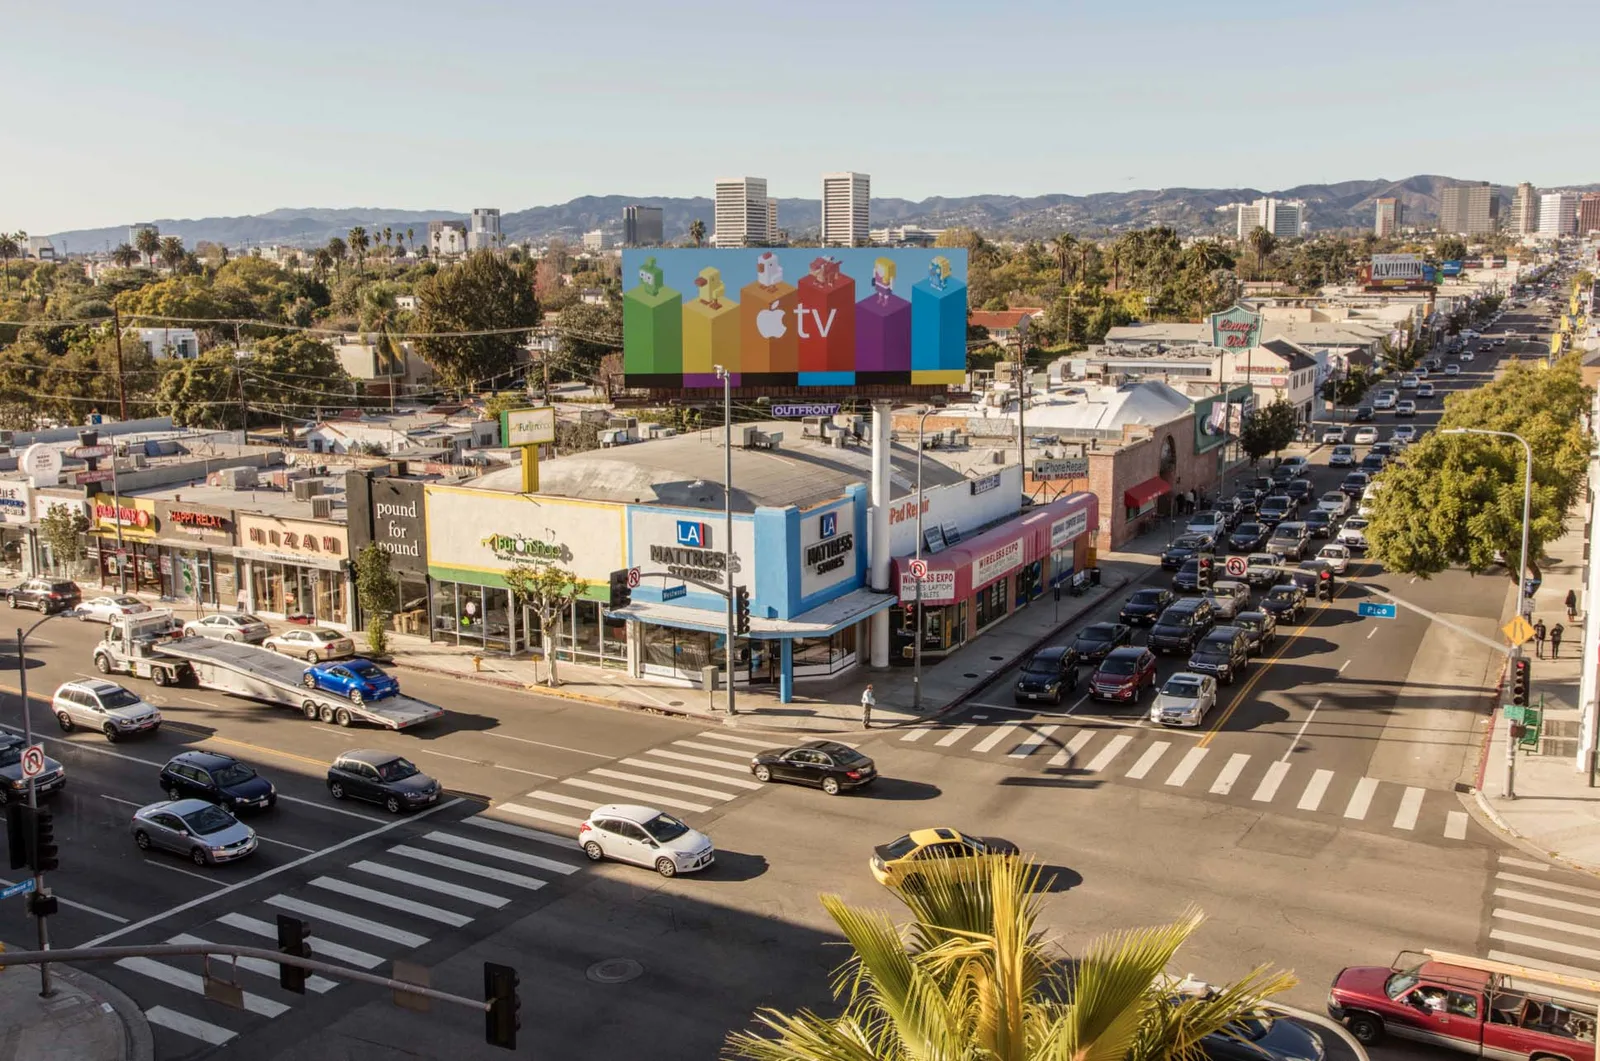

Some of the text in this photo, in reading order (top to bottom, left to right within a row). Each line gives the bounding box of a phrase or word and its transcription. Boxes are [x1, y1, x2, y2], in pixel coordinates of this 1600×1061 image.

[793, 303, 837, 338] tv
[1224, 332, 1248, 347] Deli
[774, 405, 837, 416] OUTFRONT
[1054, 471, 1085, 480] MACBOOK
[170, 510, 195, 523] HAPPY
[376, 500, 417, 519] pound
[906, 499, 930, 519] Repir
[388, 520, 407, 539] for
[677, 524, 700, 543] LA
[822, 516, 835, 536] LA
[249, 527, 335, 552] NIZAM
[807, 533, 853, 566] MATTRESS
[979, 548, 1005, 570] WIRELESS
[1005, 541, 1018, 556] EXPO
[667, 565, 718, 582] STORES
[816, 555, 845, 575] STORES
[902, 572, 954, 585] WIRSS EXPO
[902, 582, 953, 592] PHOES LAPTOPS
[662, 588, 686, 601] Westwood
[919, 590, 940, 599] ABLETS
[1367, 606, 1387, 615] Pico
